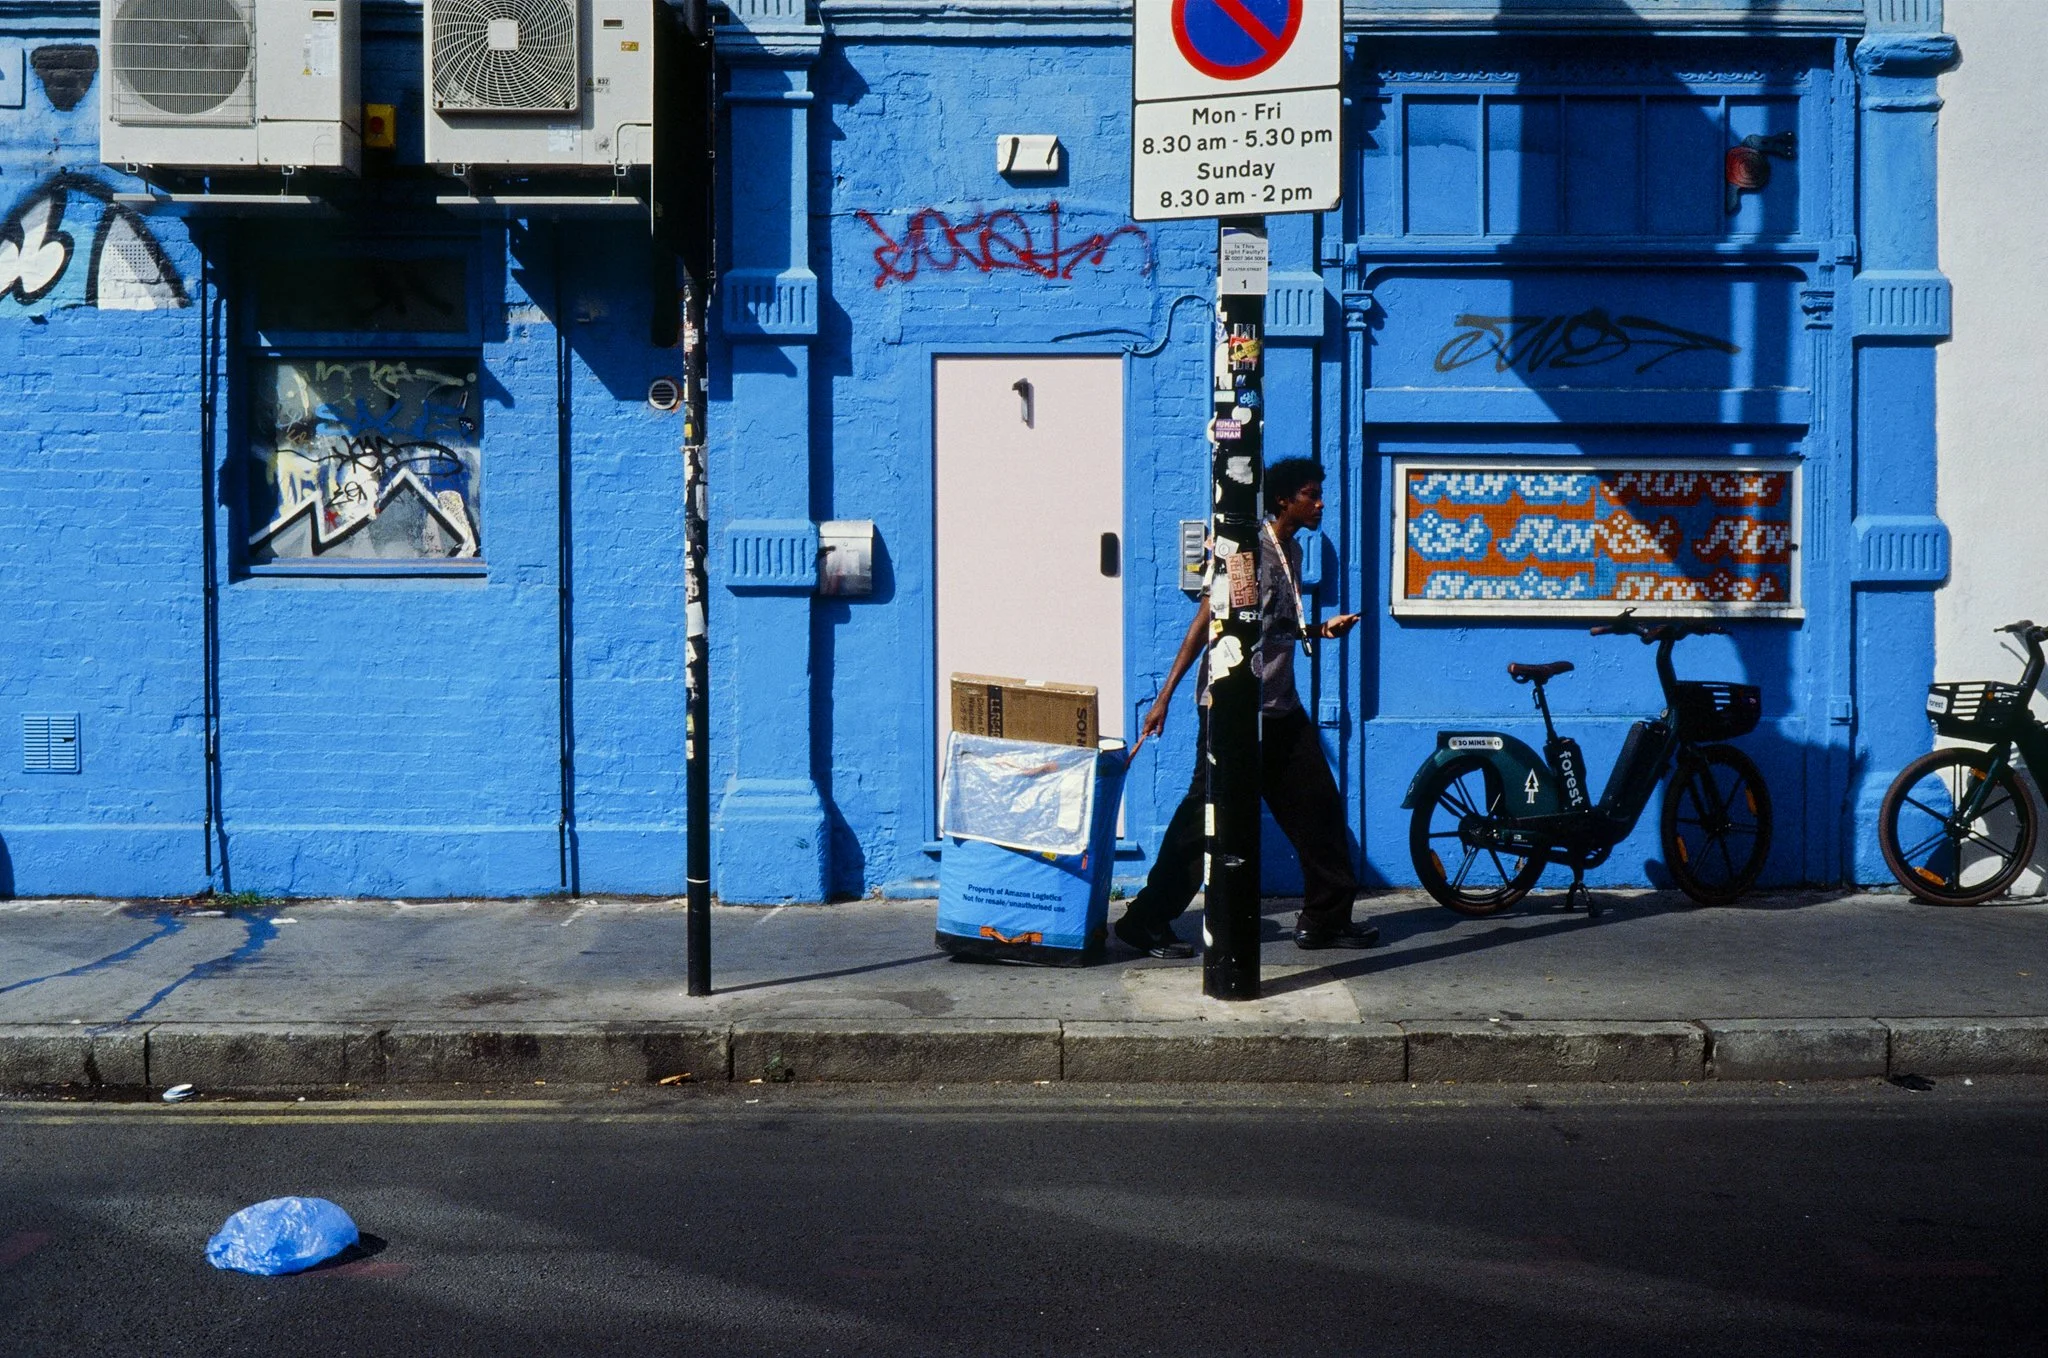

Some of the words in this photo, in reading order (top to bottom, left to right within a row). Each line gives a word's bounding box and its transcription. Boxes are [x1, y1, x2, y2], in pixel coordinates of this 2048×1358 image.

[1192, 107, 1236, 125] Mon
[1255, 102, 1281, 121] Fri
[1142, 135, 1191, 154] 8.30
[1197, 137, 1226, 151] am
[1245, 127, 1295, 148] 5.30
[1301, 129, 1332, 147] pm
[1197, 160, 1275, 180] Sunday
[1160, 189, 1209, 208] 8.30
[1215, 190, 1245, 205] am
[1263, 185, 1275, 202] 2
[1281, 186, 1312, 204] pm
[1241, 279, 1247, 289] 1
[1216, 420, 1241, 428] HUMAN
[1216, 430, 1241, 439] HUMAN
[1559, 751, 1584, 806] forest
[962, 893, 974, 902] Not
[975, 895, 984, 903] for
[985, 896, 1052, 912] resale/unauthorised
[1053, 905, 1065, 913] use
[968, 884, 995, 896] Property
[997, 887, 1003, 895] of
[1004, 888, 1031, 899] Amazon
[1032, 892, 1062, 902] Logistics
